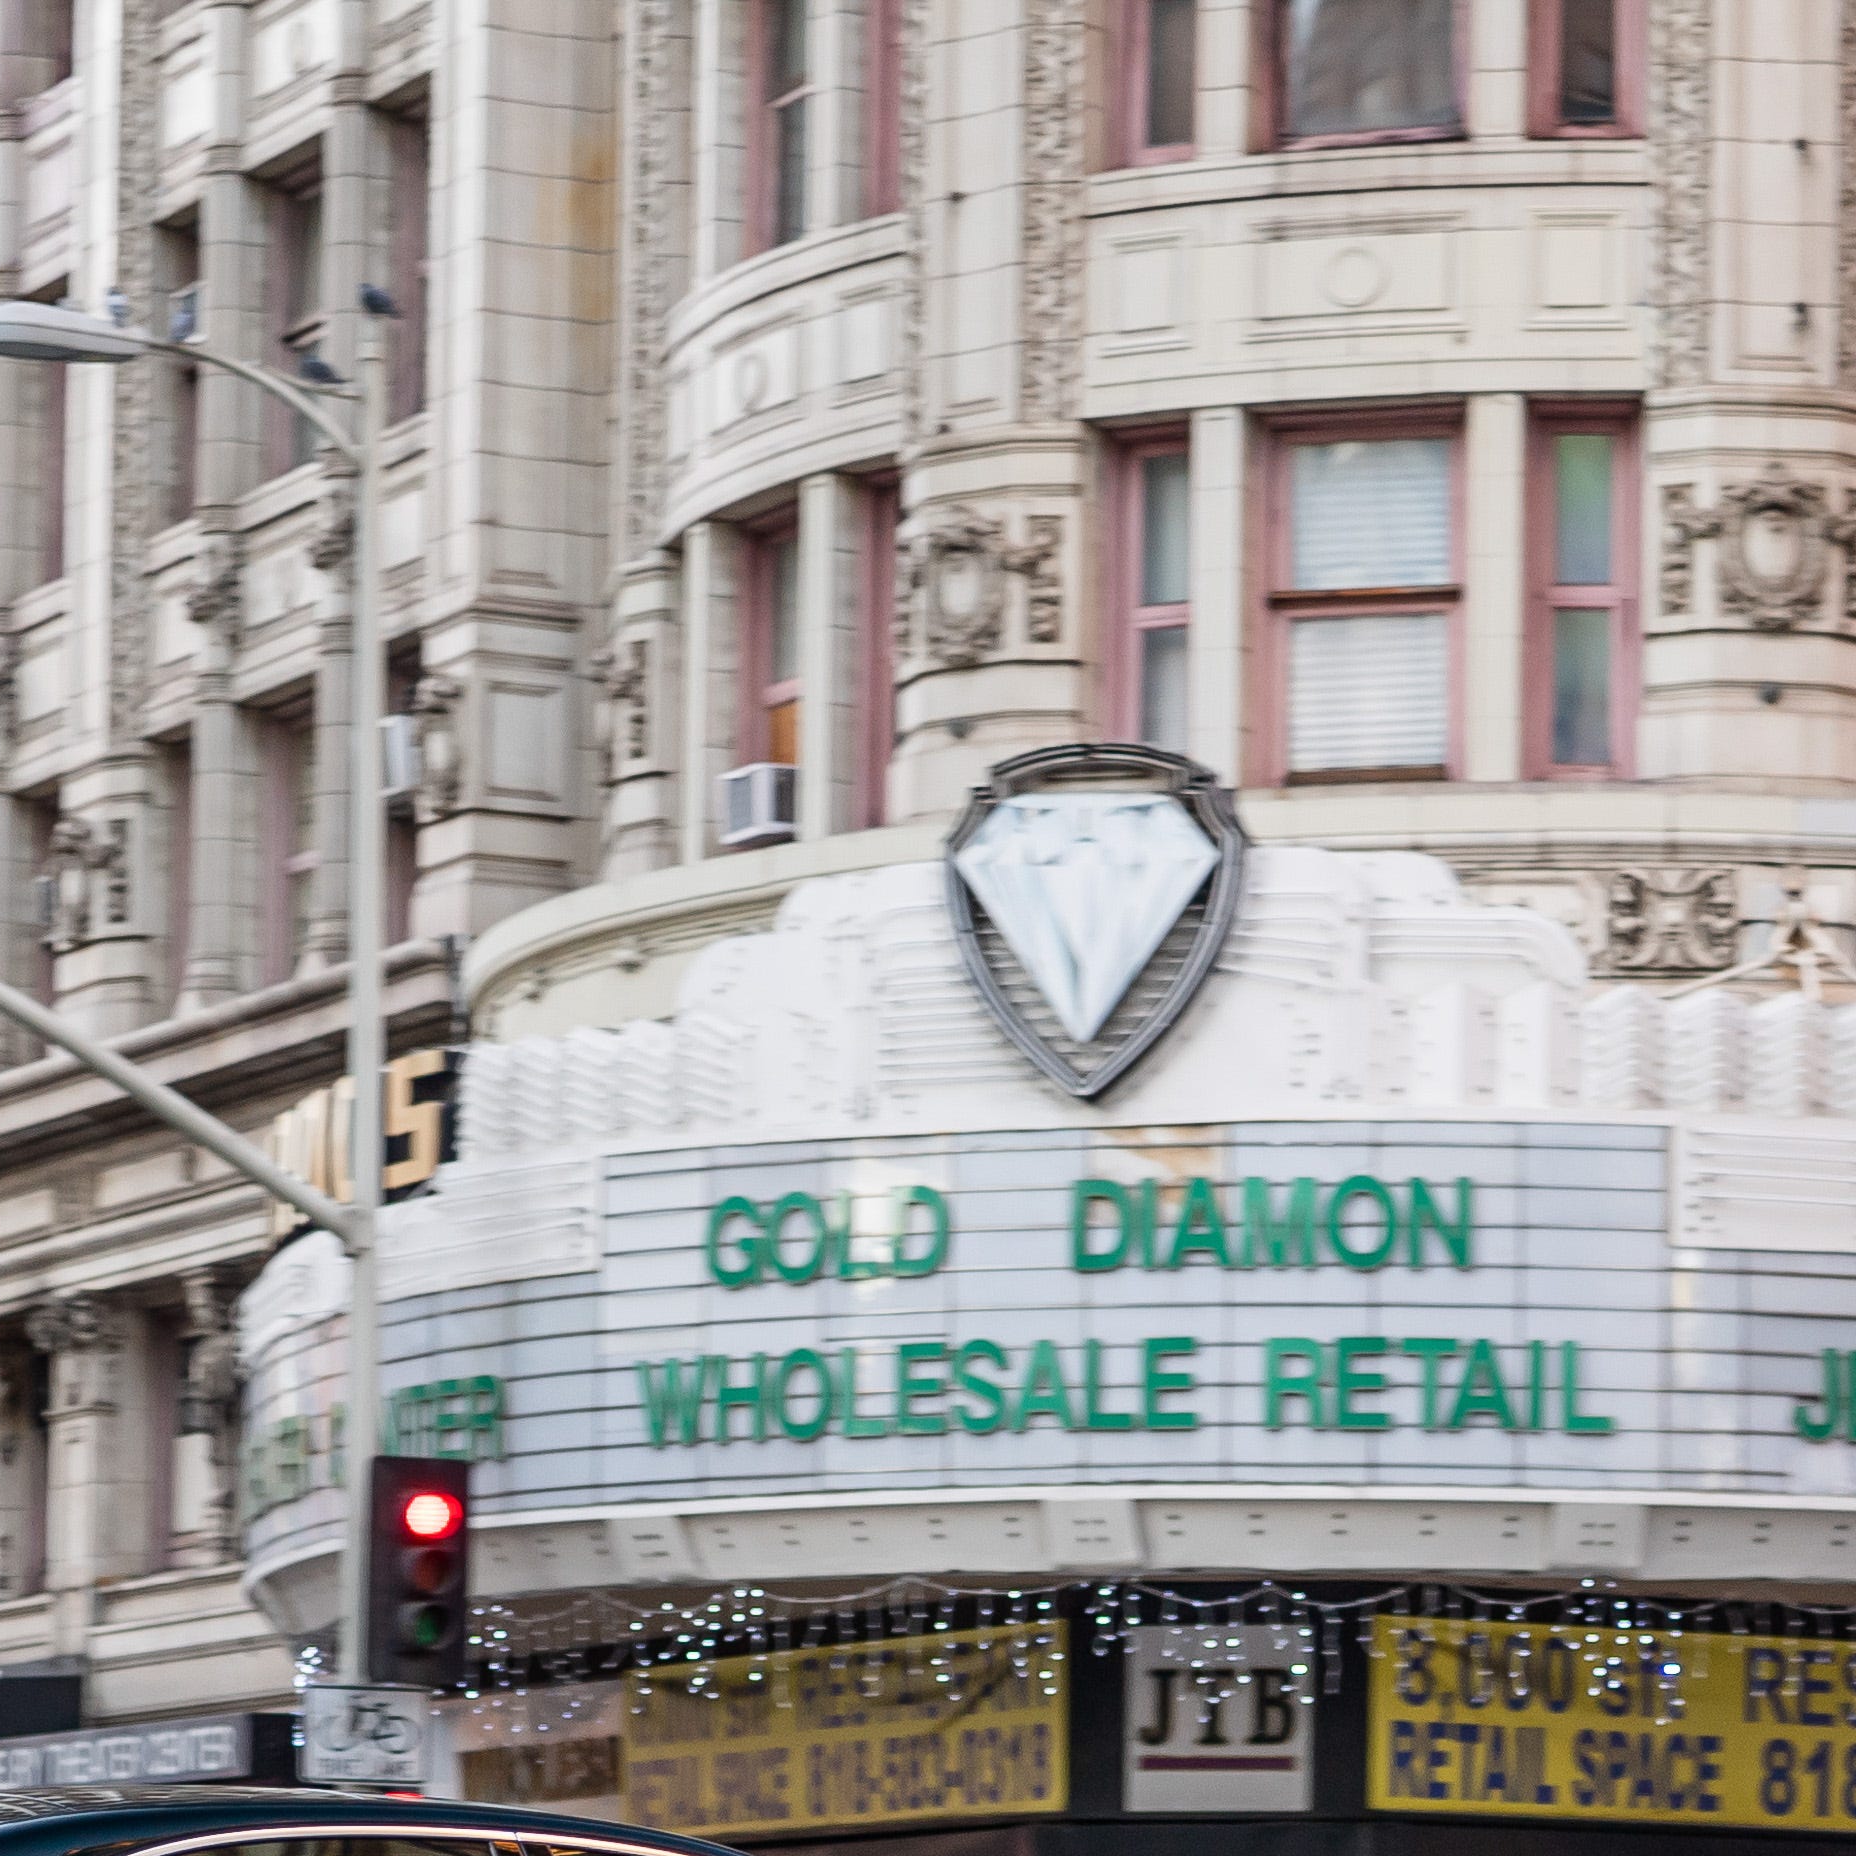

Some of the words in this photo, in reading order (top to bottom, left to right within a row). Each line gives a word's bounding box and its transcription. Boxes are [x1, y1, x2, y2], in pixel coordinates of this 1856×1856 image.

[706, 1186, 951, 1289] GOLD
[1070, 1174, 1474, 1273] DIAMON
[638, 1336, 1199, 1448] WHOLESALE
[1265, 1336, 1617, 1436] RETAIL
[1136, 1666, 1298, 1748] JTB
[1390, 1719, 1557, 1807] RETAIL
[1573, 1729, 1722, 1813] SPACE
